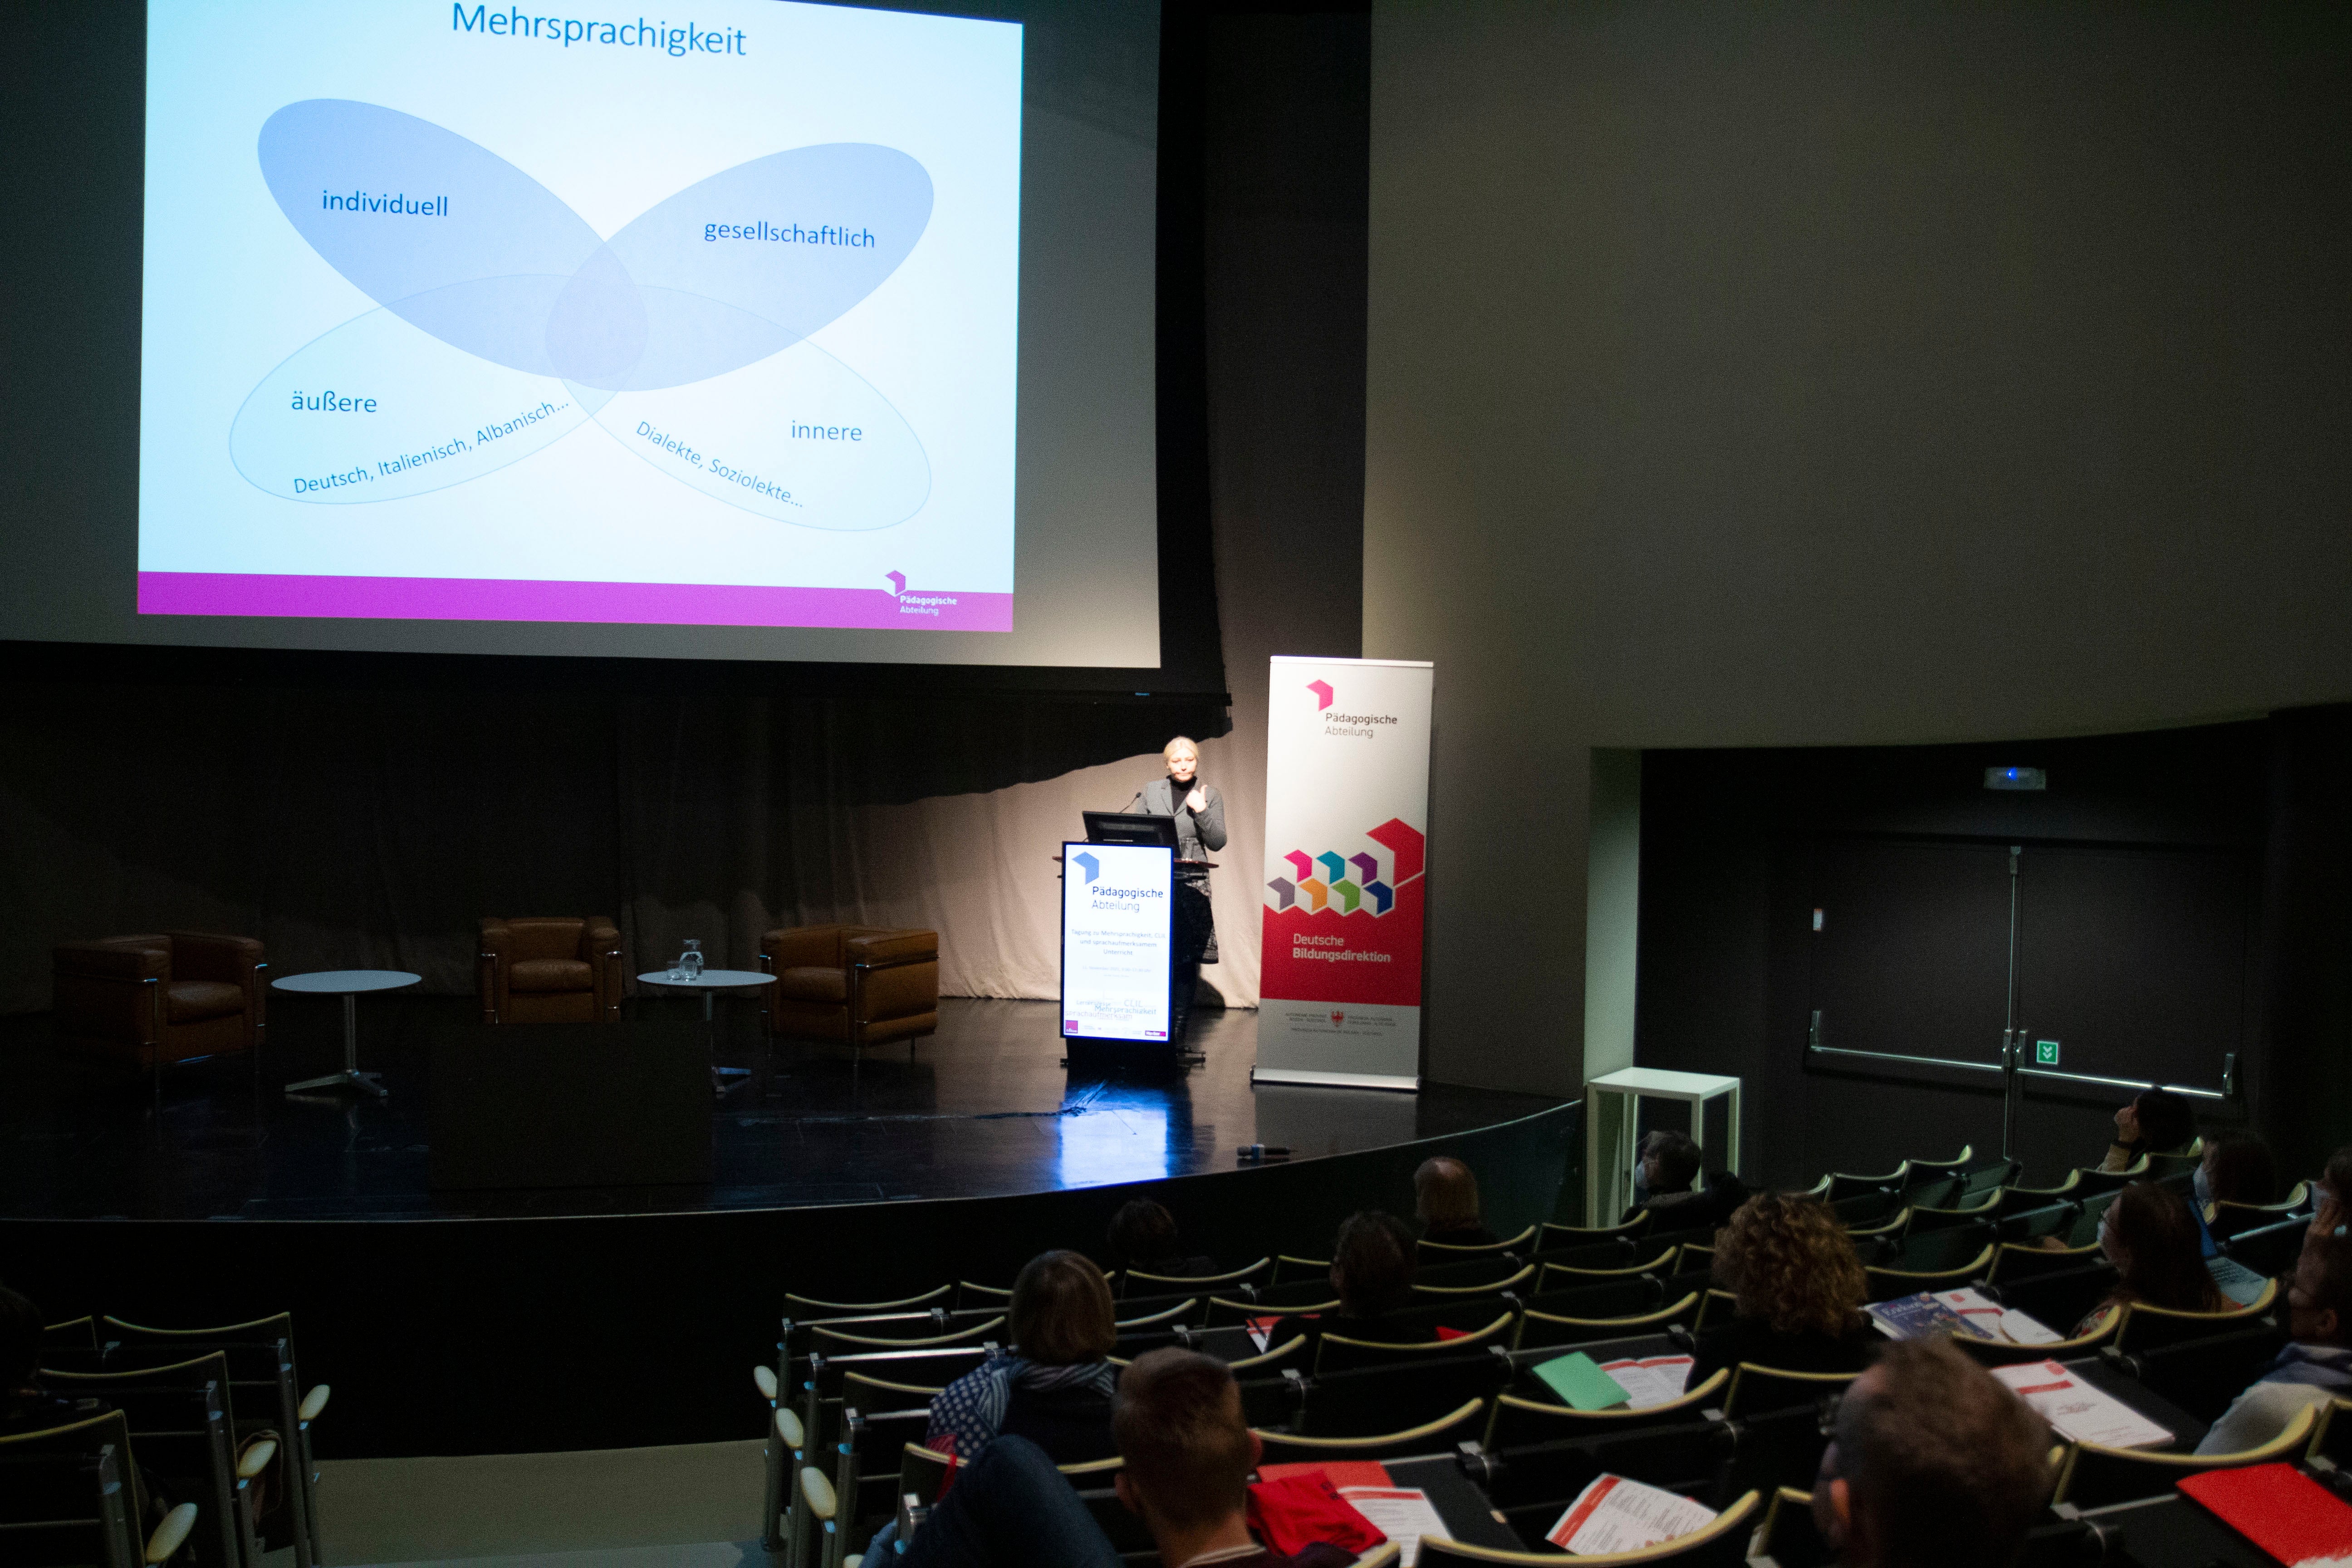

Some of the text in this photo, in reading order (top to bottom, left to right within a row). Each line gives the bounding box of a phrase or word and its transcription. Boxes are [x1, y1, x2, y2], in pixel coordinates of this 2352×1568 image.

[453, 3, 746, 57] Mehrsprachigkeit
[323, 190, 447, 216] individuell
[704, 221, 874, 248] gesellschaftlich
[291, 391, 377, 413] äußere
[791, 420, 862, 441] innere
[636, 421, 704, 469] Dialekte,
[294, 466, 374, 494] Deutsch,
[377, 438, 473, 476] Italienisch,
[900, 595, 957, 606] Pädagogische
[900, 606, 939, 616] Abteilung
[1326, 713, 1398, 725] Pädagogische
[1325, 726, 1373, 739] Abteilung
[1092, 886, 1164, 898] Pädagogische
[1091, 900, 1140, 913] Abteilung
[1293, 933, 1344, 946] Deutsche
[1293, 947, 1391, 962] Bildungsdirektion
[1124, 999, 1143, 1007] CLIL
[1065, 1010, 1133, 1019] sprachaufmerksam
[1094, 1005, 1157, 1015] Mehrsprachigkeit
